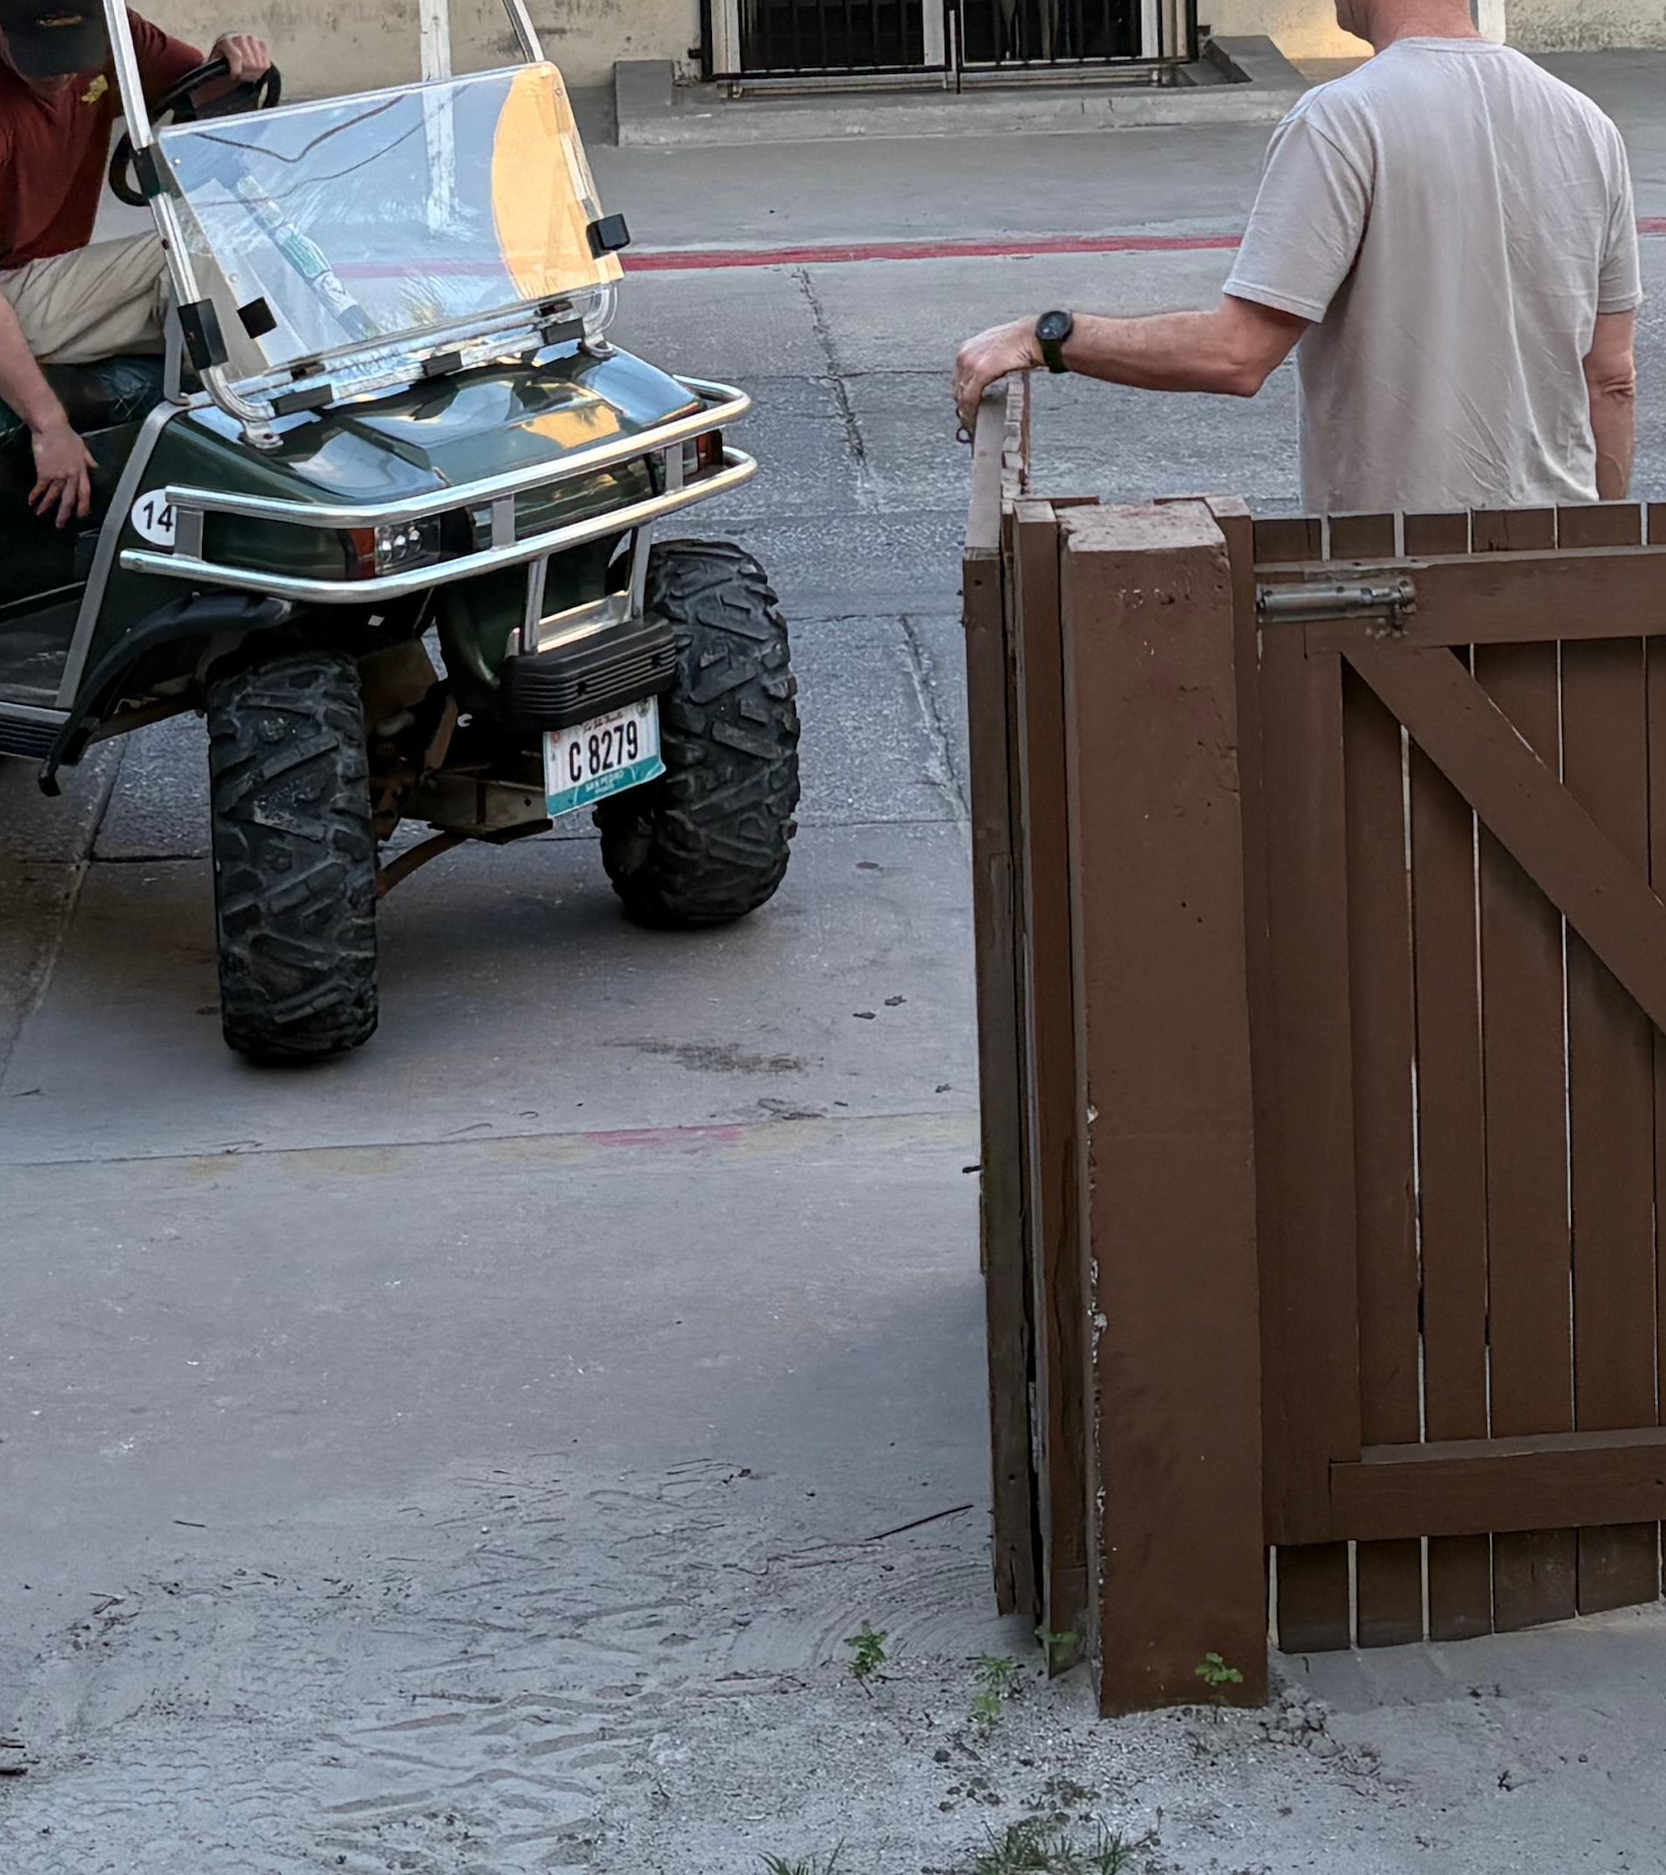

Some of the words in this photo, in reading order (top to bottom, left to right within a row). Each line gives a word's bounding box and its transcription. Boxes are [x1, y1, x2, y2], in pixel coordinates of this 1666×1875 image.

[143, 500, 174, 533] 14
[568, 741, 582, 783] C
[588, 720, 638, 775] 8279
